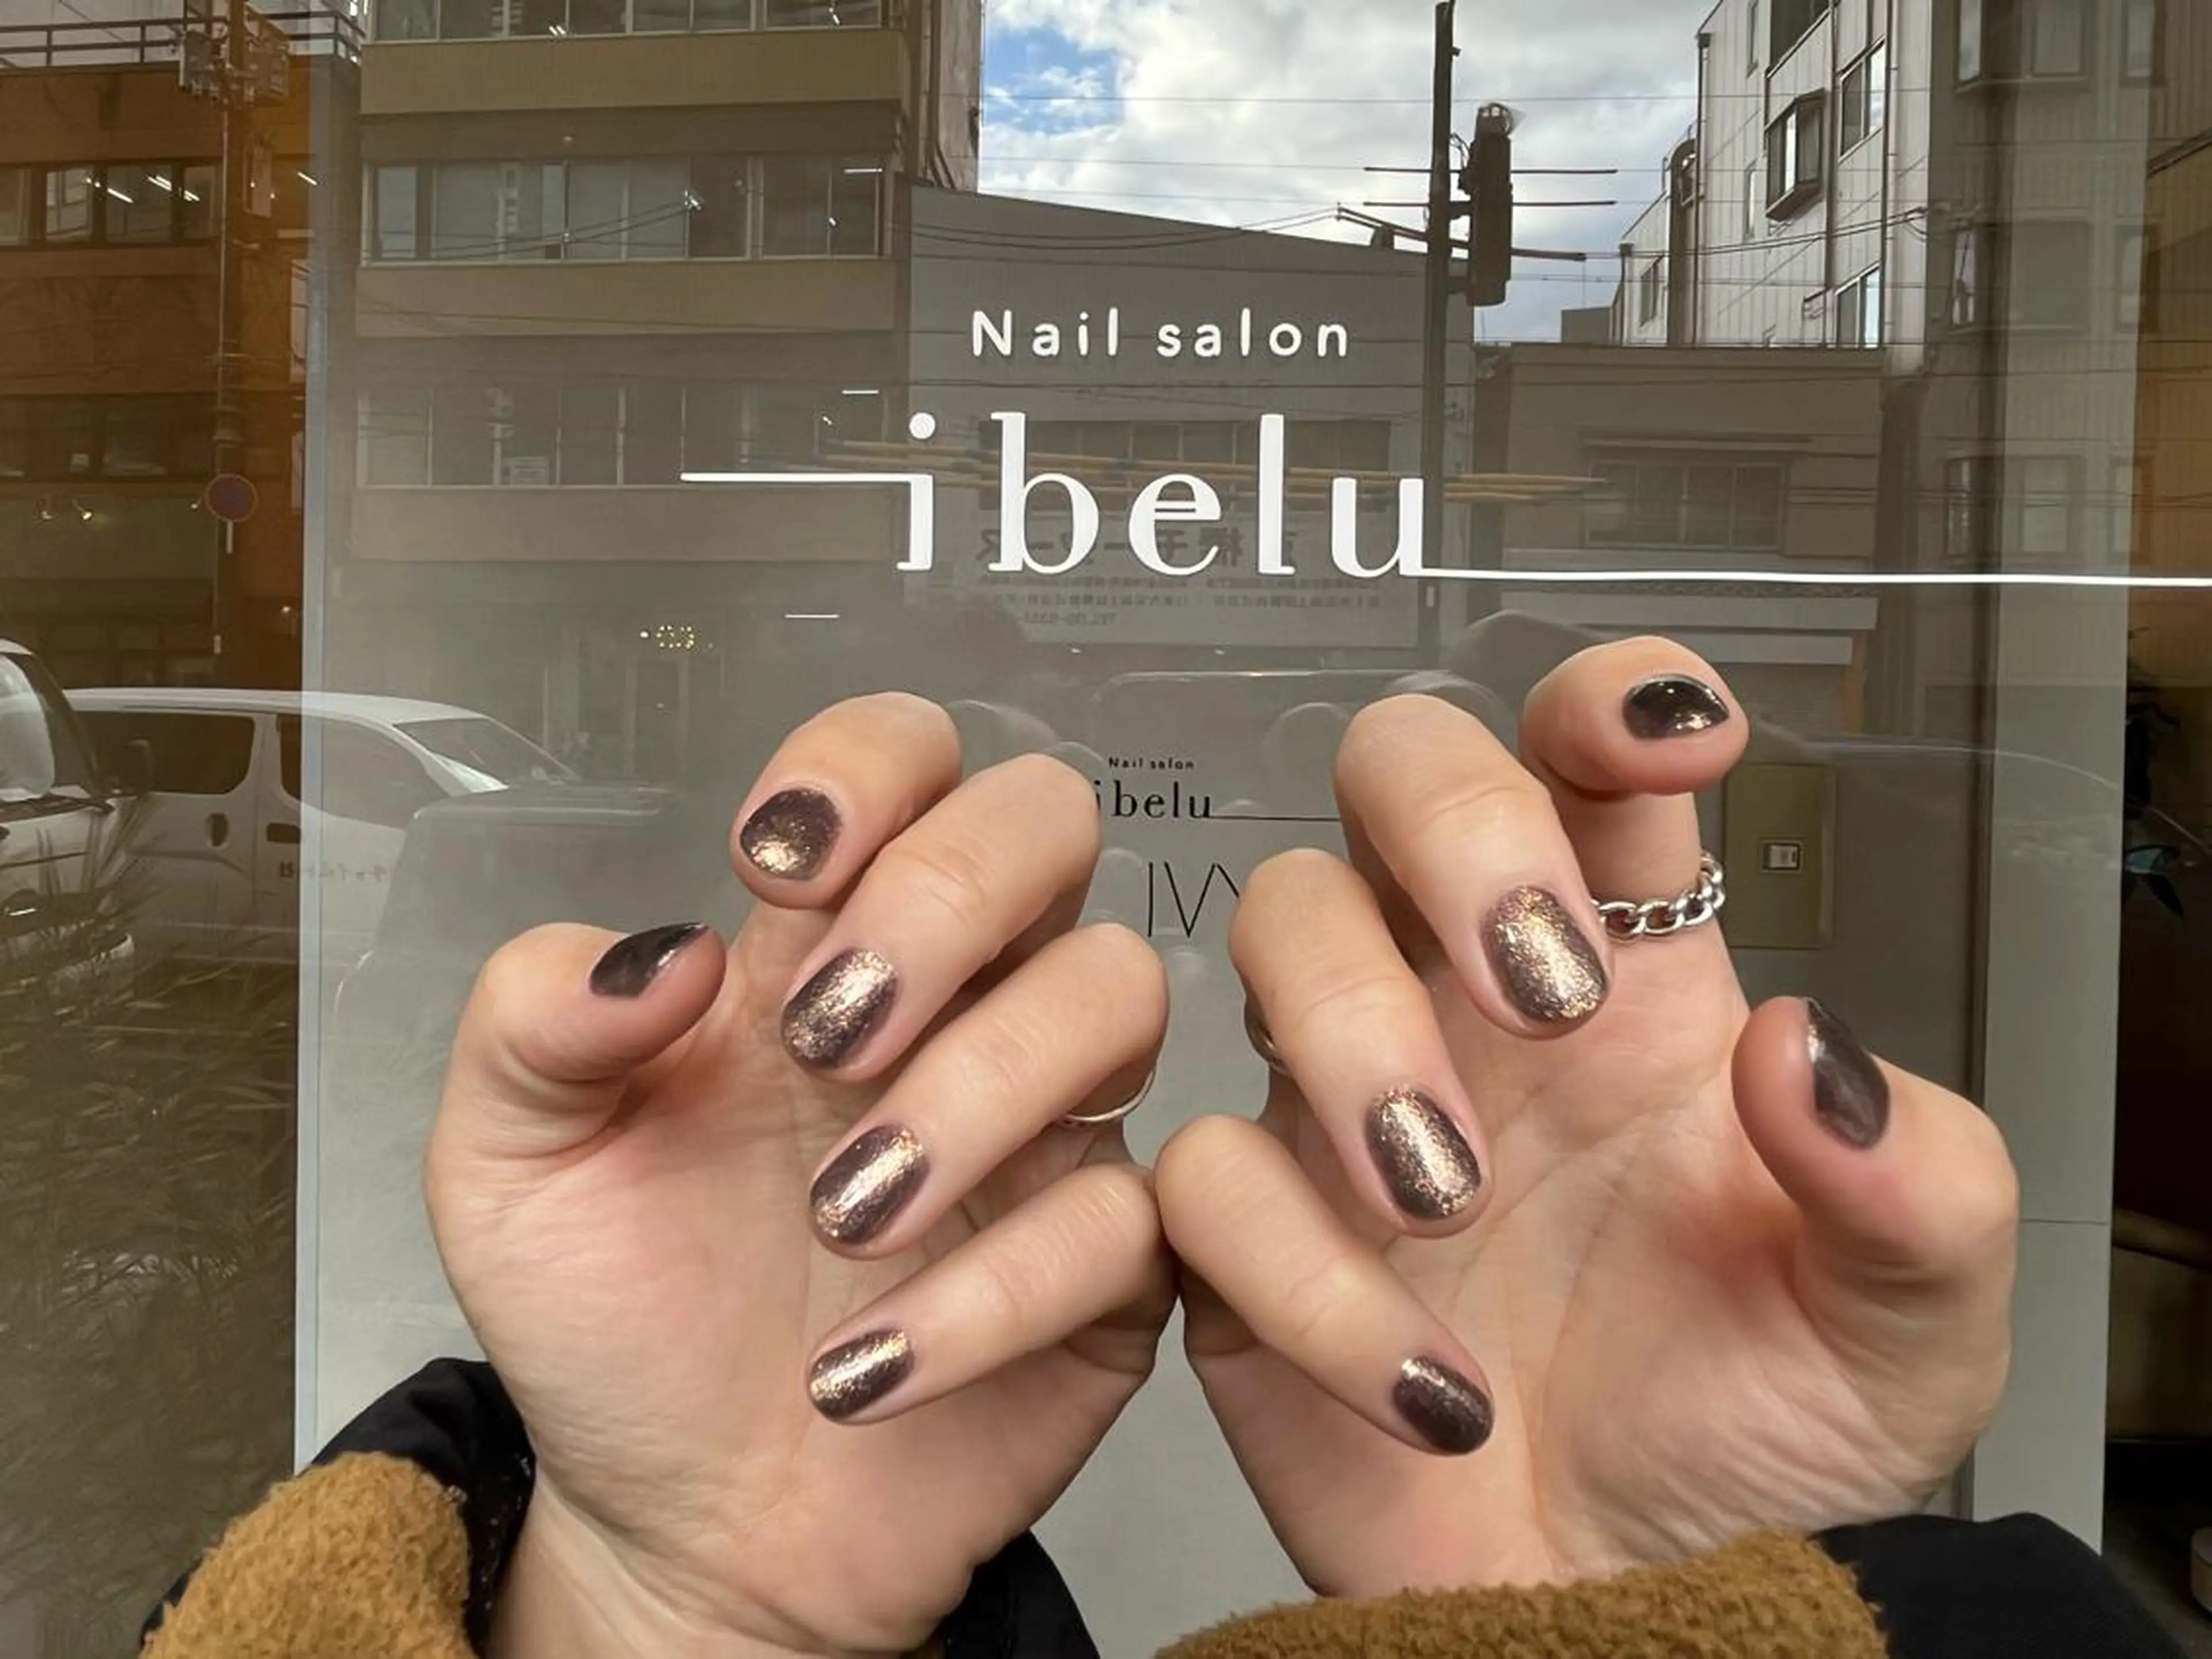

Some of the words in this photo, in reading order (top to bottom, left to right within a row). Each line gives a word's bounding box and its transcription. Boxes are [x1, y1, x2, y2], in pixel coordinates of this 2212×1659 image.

[972, 307, 1119, 356] Nail
[1157, 307, 1347, 357] salon
[897, 411, 1425, 577] ibelu
[1109, 756, 1143, 768] Nail
[1150, 757, 1195, 770] salon
